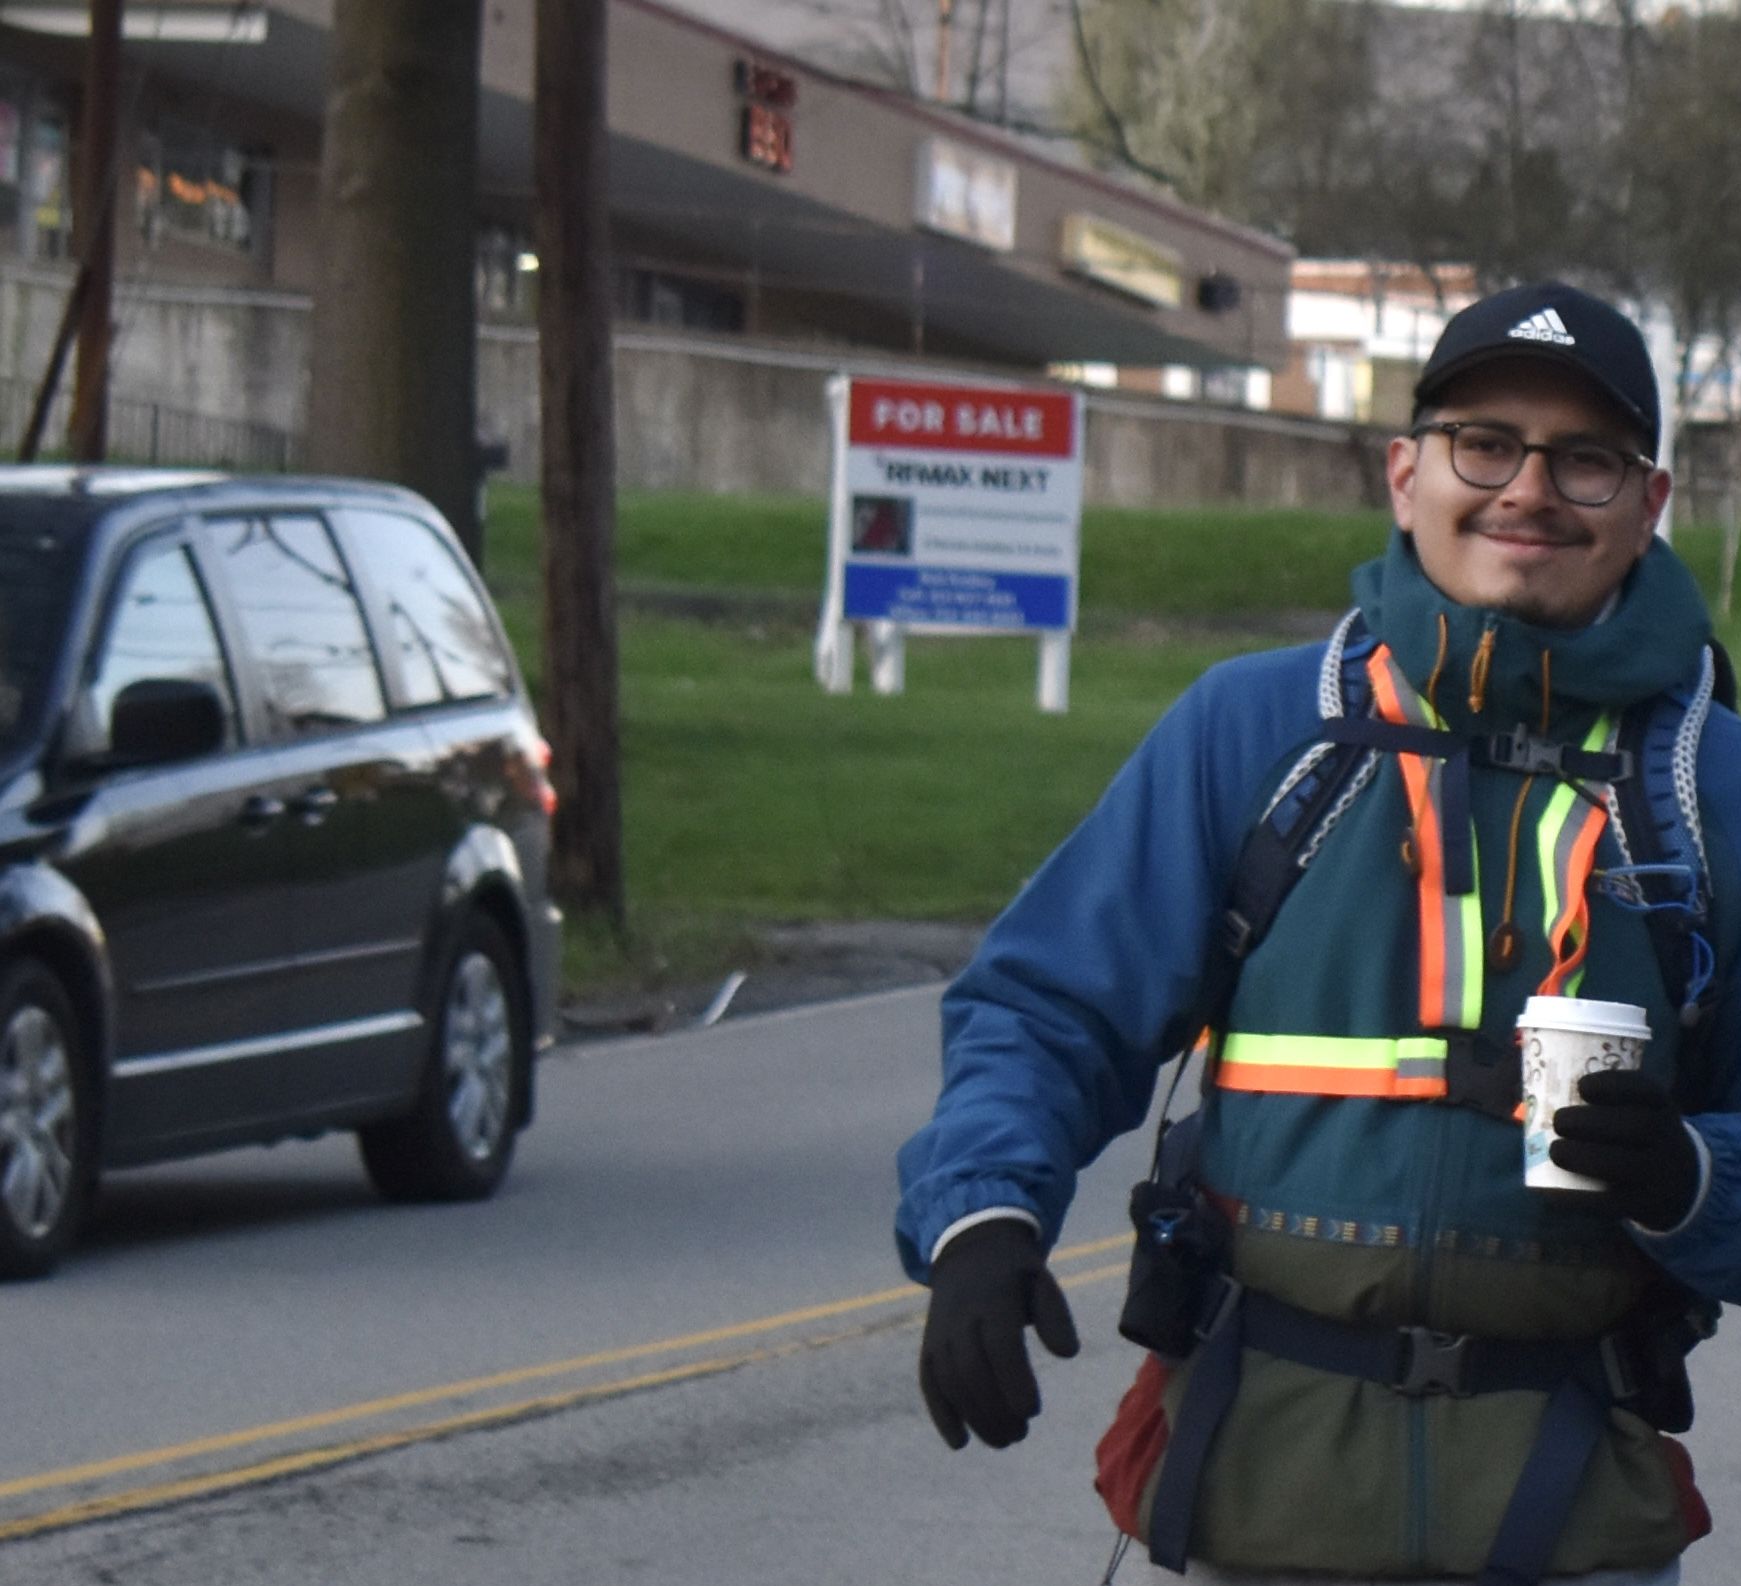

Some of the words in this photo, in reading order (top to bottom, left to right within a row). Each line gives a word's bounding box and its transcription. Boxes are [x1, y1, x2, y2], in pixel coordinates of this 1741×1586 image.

[1508, 328, 1575, 345] adidas
[873, 398, 945, 433] FOR
[955, 401, 1044, 441] SALE
